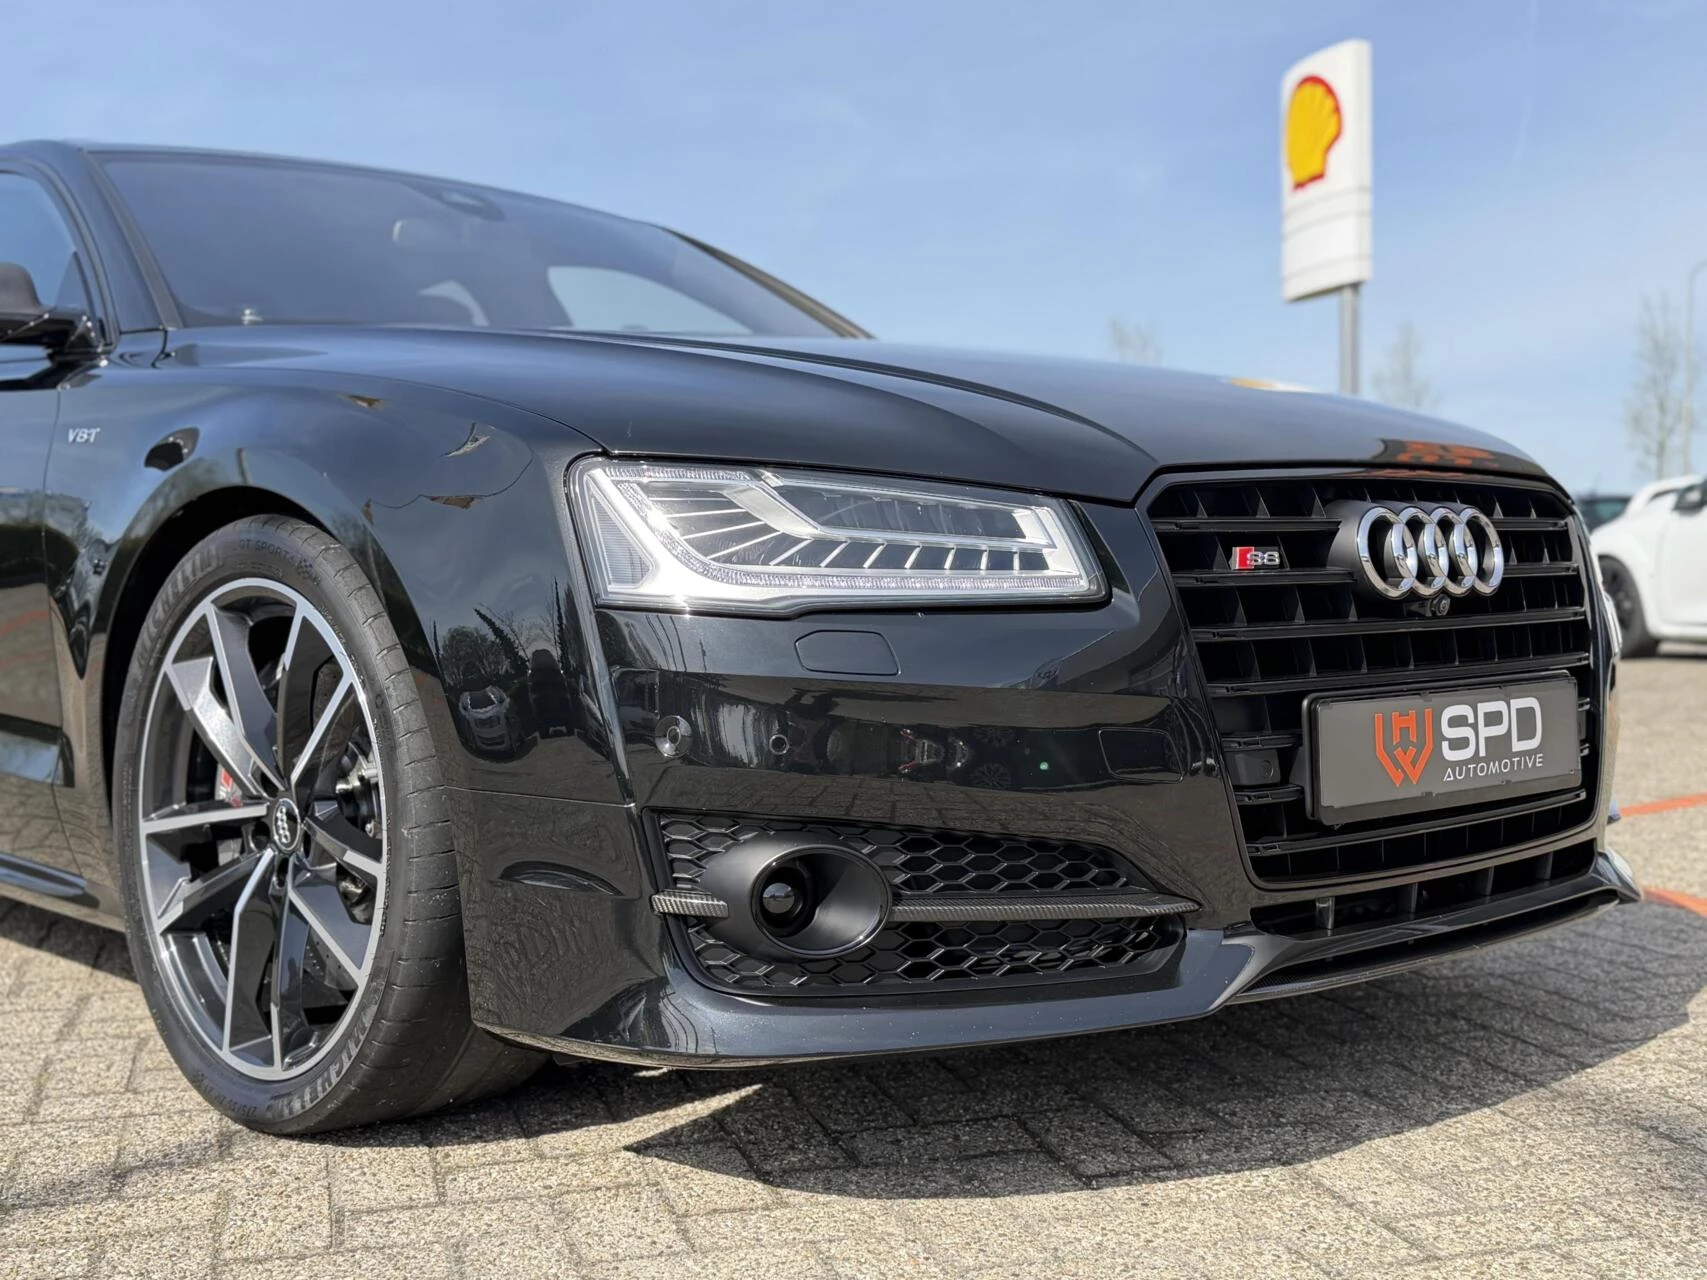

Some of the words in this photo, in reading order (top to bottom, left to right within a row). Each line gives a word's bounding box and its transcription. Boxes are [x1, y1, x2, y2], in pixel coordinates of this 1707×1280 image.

[67, 427, 101, 443] V8T
[1246, 551, 1280, 566] S8
[1440, 696, 1543, 761] SPD
[1443, 753, 1544, 782] AUTOMOTIVE
